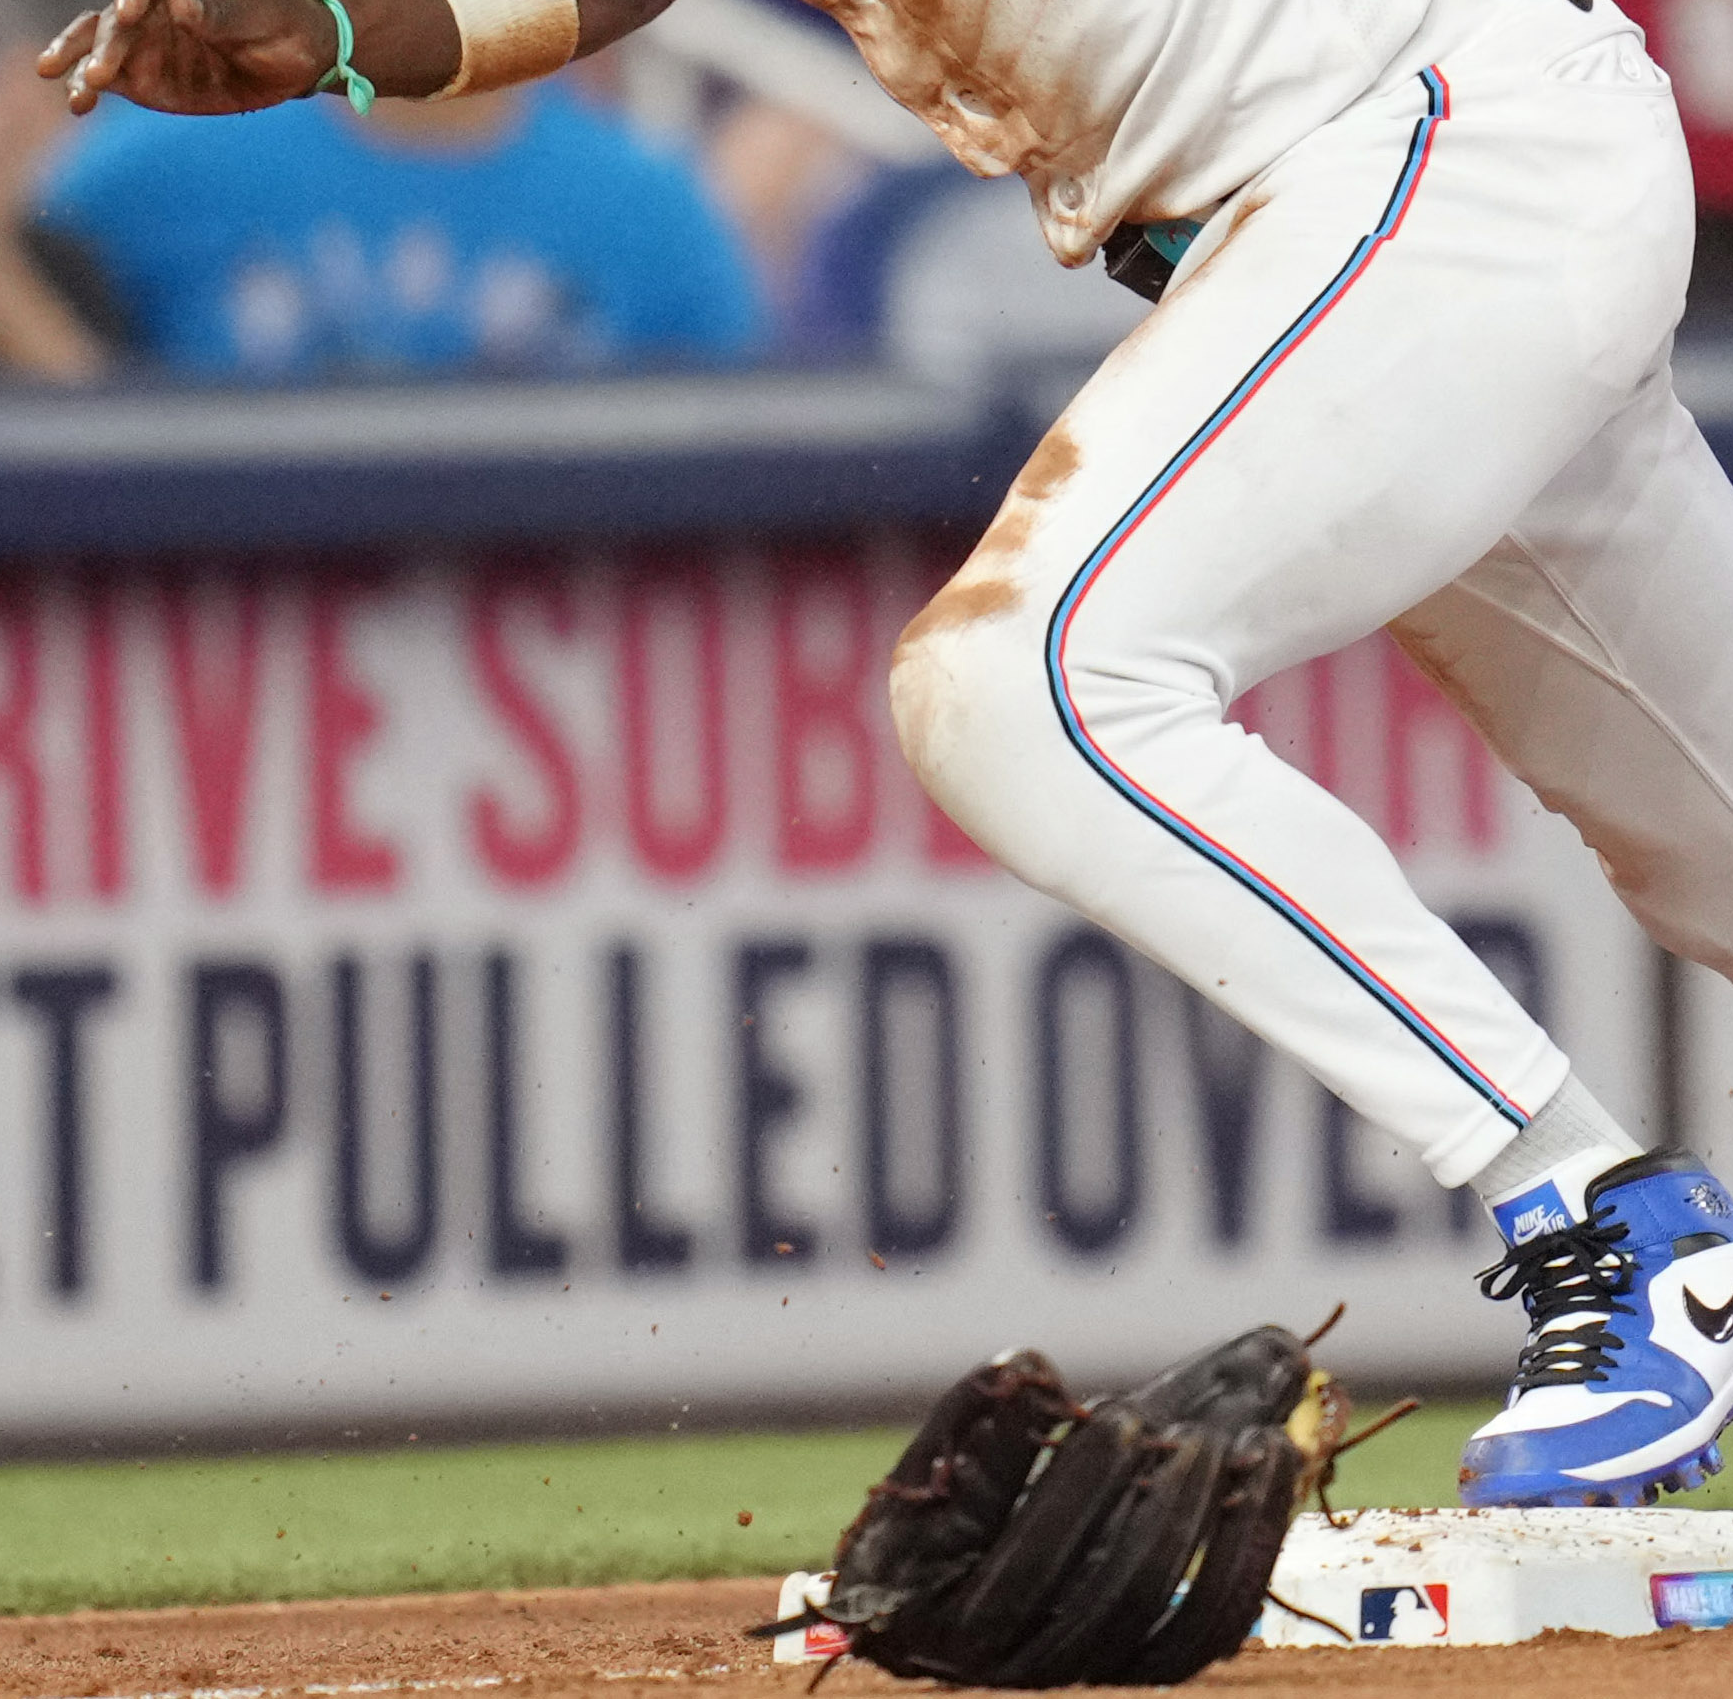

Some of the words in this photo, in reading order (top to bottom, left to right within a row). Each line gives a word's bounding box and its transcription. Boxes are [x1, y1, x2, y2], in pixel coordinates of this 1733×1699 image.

[464, 537, 998, 884] SOB
[184, 927, 962, 1294] PULLED
[1514, 1204, 1545, 1234] NIKE
[1543, 1213, 1567, 1235] AIR
